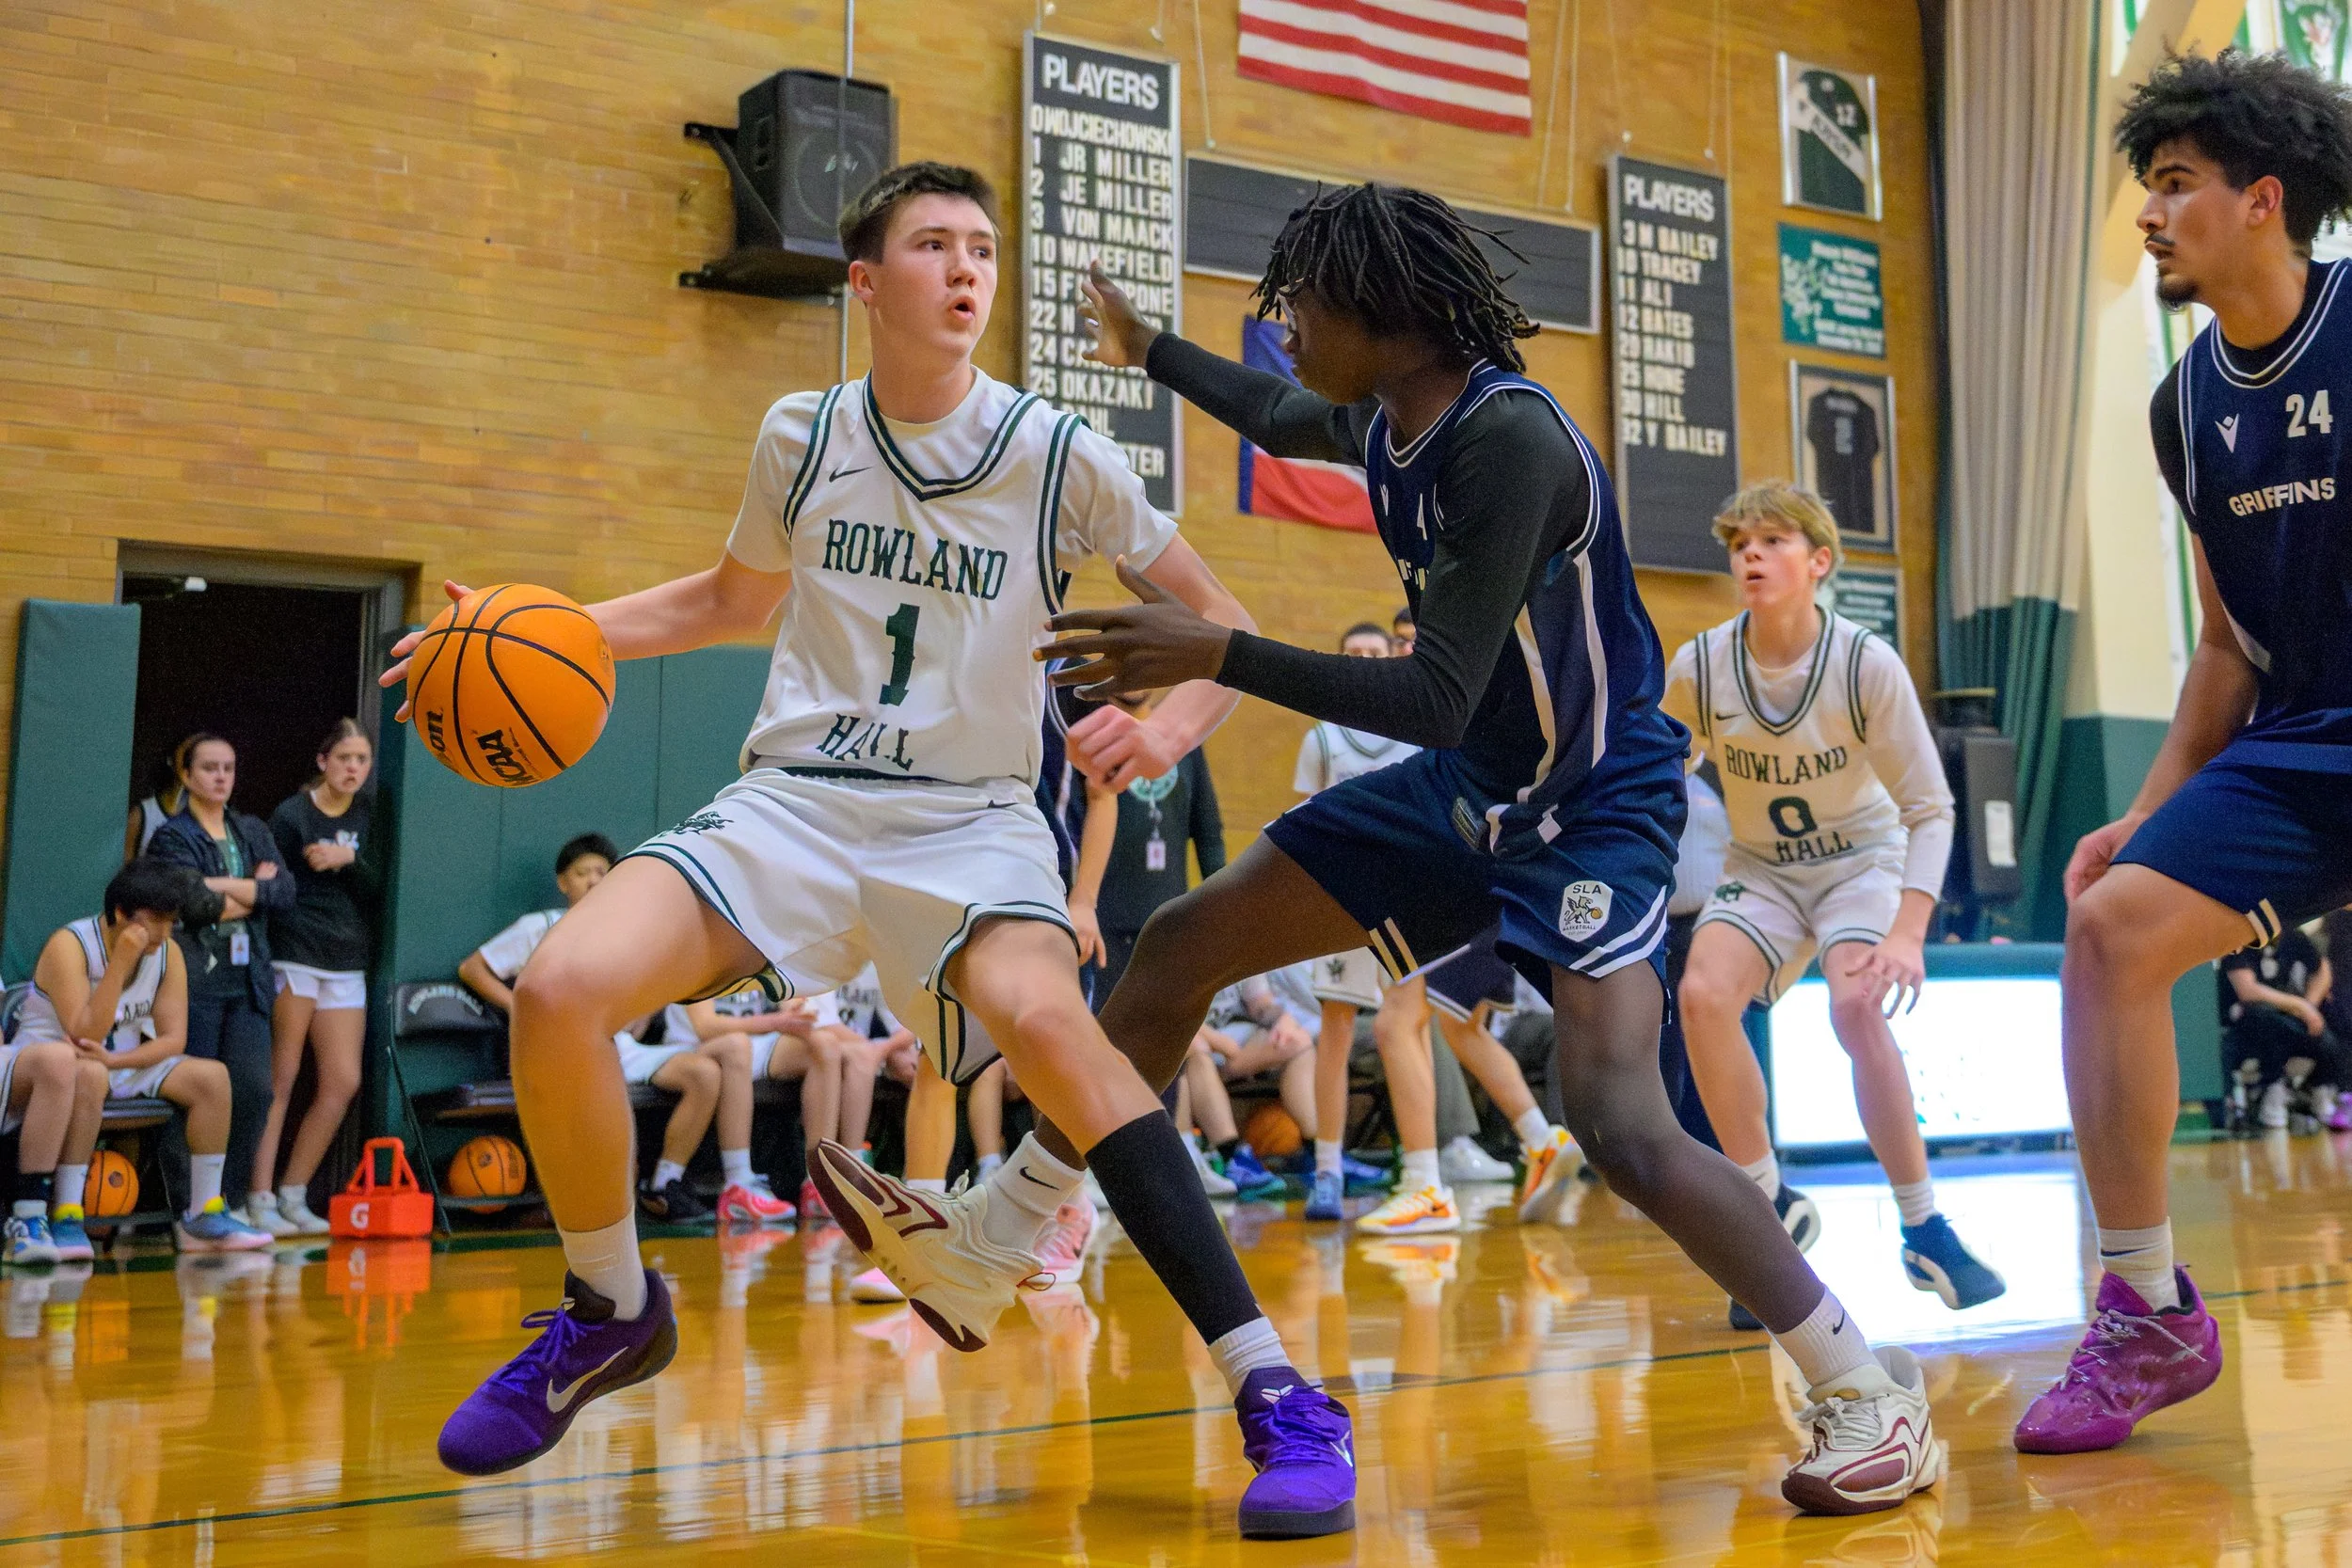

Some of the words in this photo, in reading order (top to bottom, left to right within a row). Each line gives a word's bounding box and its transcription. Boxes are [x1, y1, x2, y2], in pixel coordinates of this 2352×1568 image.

[1041, 53, 1159, 110] PLAYERS
[1033, 136, 1041, 165] 1
[1059, 142, 1087, 172] JR
[1097, 148, 1172, 187] MILLER
[1031, 168, 1044, 198] 2
[1059, 173, 1087, 204] JE
[1096, 179, 1172, 221] MILLER
[1624, 173, 1715, 223] PLAYERS
[1031, 200, 1044, 230] 3
[1061, 204, 1100, 239] VON
[1106, 213, 1173, 252] MAACK
[1032, 234, 1057, 264] 10
[1032, 267, 1057, 298] 15
[1029, 300, 1057, 330] 22
[1029, 332, 1057, 365] 24
[1029, 365, 1057, 398] 25
[1061, 370, 1153, 411] OKAZAKI
[2285, 389, 2334, 438] 24
[2228, 477, 2336, 516] GRIFFINS
[822, 519, 1009, 601] ROWLAND
[879, 603, 921, 707] 1
[816, 713, 914, 771] HALL
[1724, 743, 1849, 785] ROWLAND
[1768, 797, 1818, 838] 0
[1775, 831, 1854, 863] HALL
[1572, 884, 1602, 895] SLA
[350, 1202, 370, 1230] G
